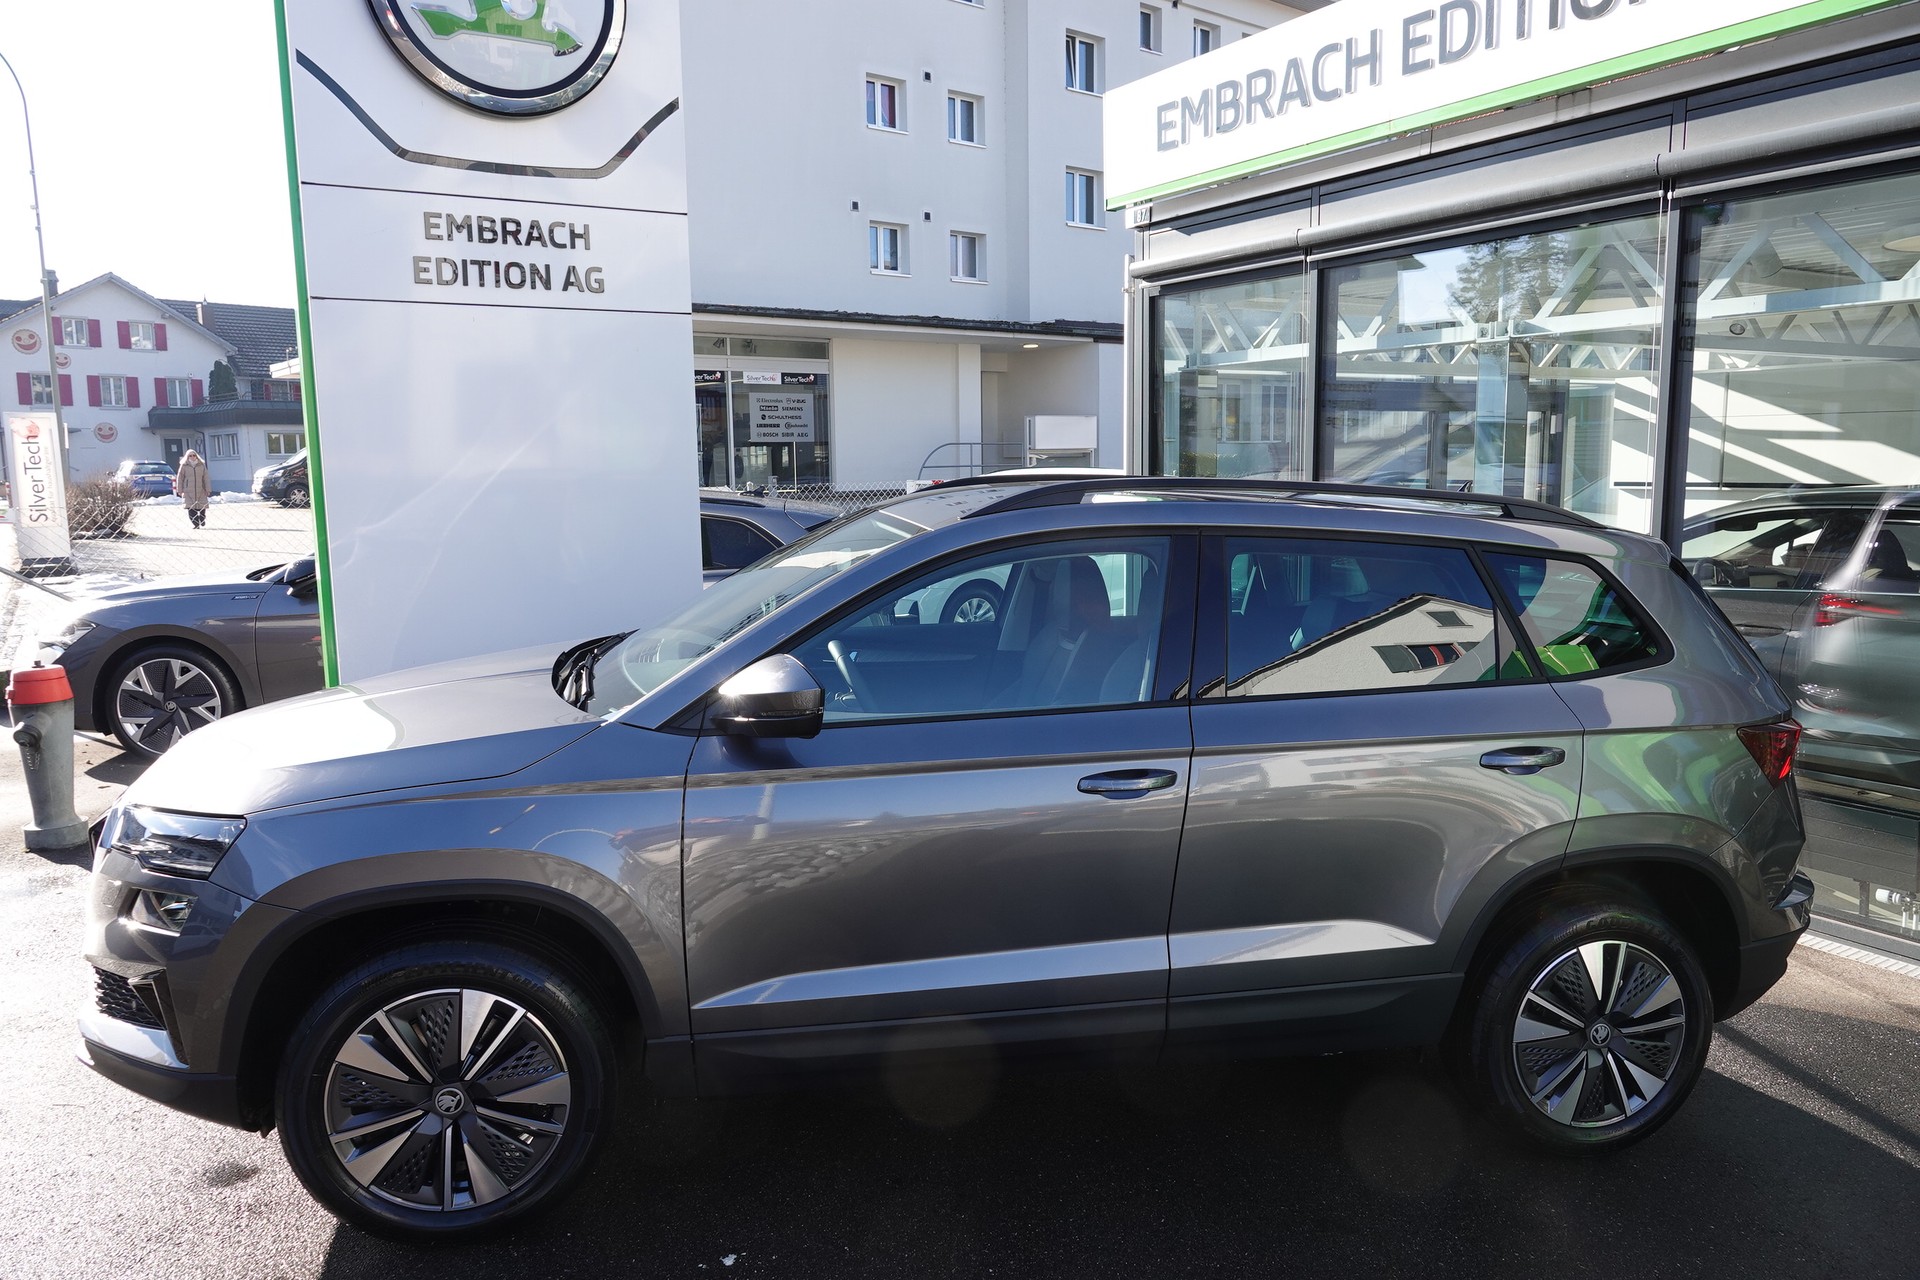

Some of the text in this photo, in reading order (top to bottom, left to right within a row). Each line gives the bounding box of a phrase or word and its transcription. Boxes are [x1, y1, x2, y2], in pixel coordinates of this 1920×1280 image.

[1156, 0, 1646, 153] EMBRACH EDIT
[423, 211, 591, 251] EMBRACH
[412, 255, 605, 294] EDITION AG
